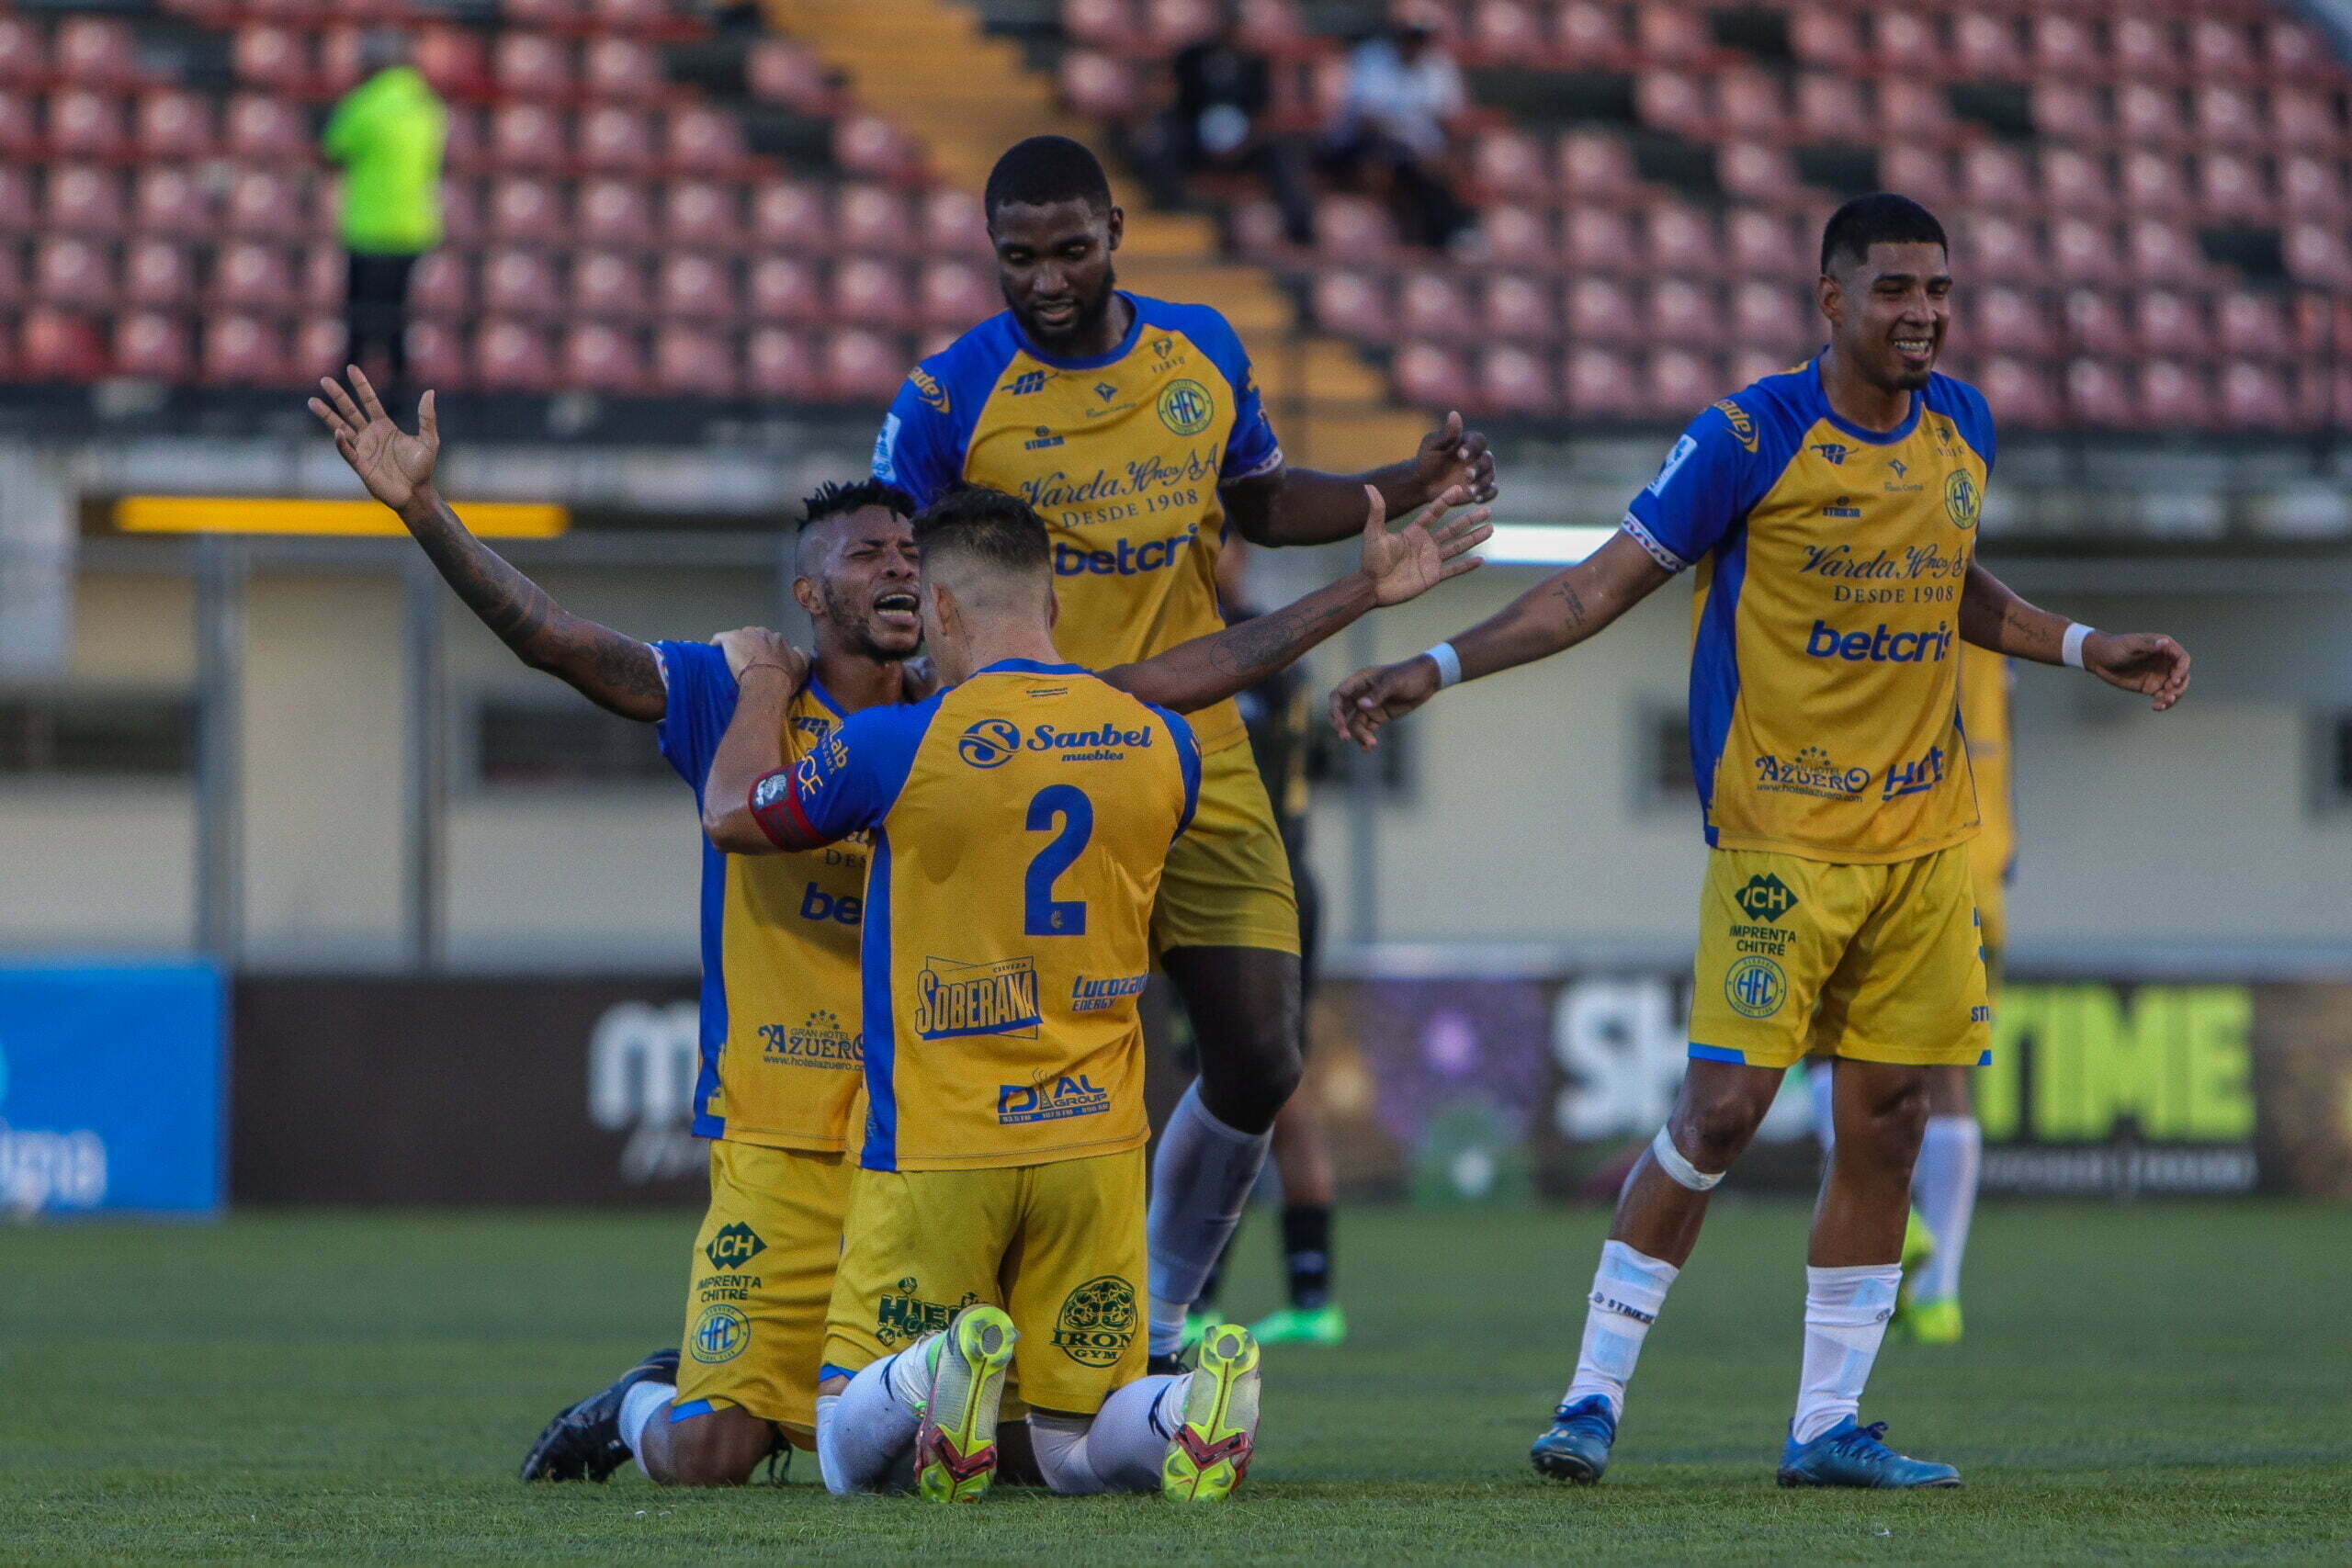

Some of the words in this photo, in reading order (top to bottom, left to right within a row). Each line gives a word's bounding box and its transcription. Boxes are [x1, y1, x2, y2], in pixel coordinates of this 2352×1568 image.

[1021, 469, 1119, 507] Varela
[1061, 502, 1139, 529] DESDE
[1146, 489, 1198, 513] 1908
[1055, 522, 1198, 577] betcri
[1799, 544, 1896, 579] Varela
[1834, 584, 1905, 604] DESDE
[1914, 585, 1954, 603] 1908
[1026, 723, 1153, 751] Sanbel
[1061, 750, 1124, 761] muebles
[1755, 754, 1871, 793] AZUERO
[1024, 784, 1093, 936] 2
[799, 882, 863, 925] be
[1729, 925, 1796, 943] IMPRENTA
[1054, 1093, 1107, 1107] GROUP
[712, 1235, 754, 1258] ICH
[696, 1275, 762, 1291] IMPRENTA
[1049, 1330, 1132, 1349] IRON
[1075, 1349, 1118, 1359] GYM
